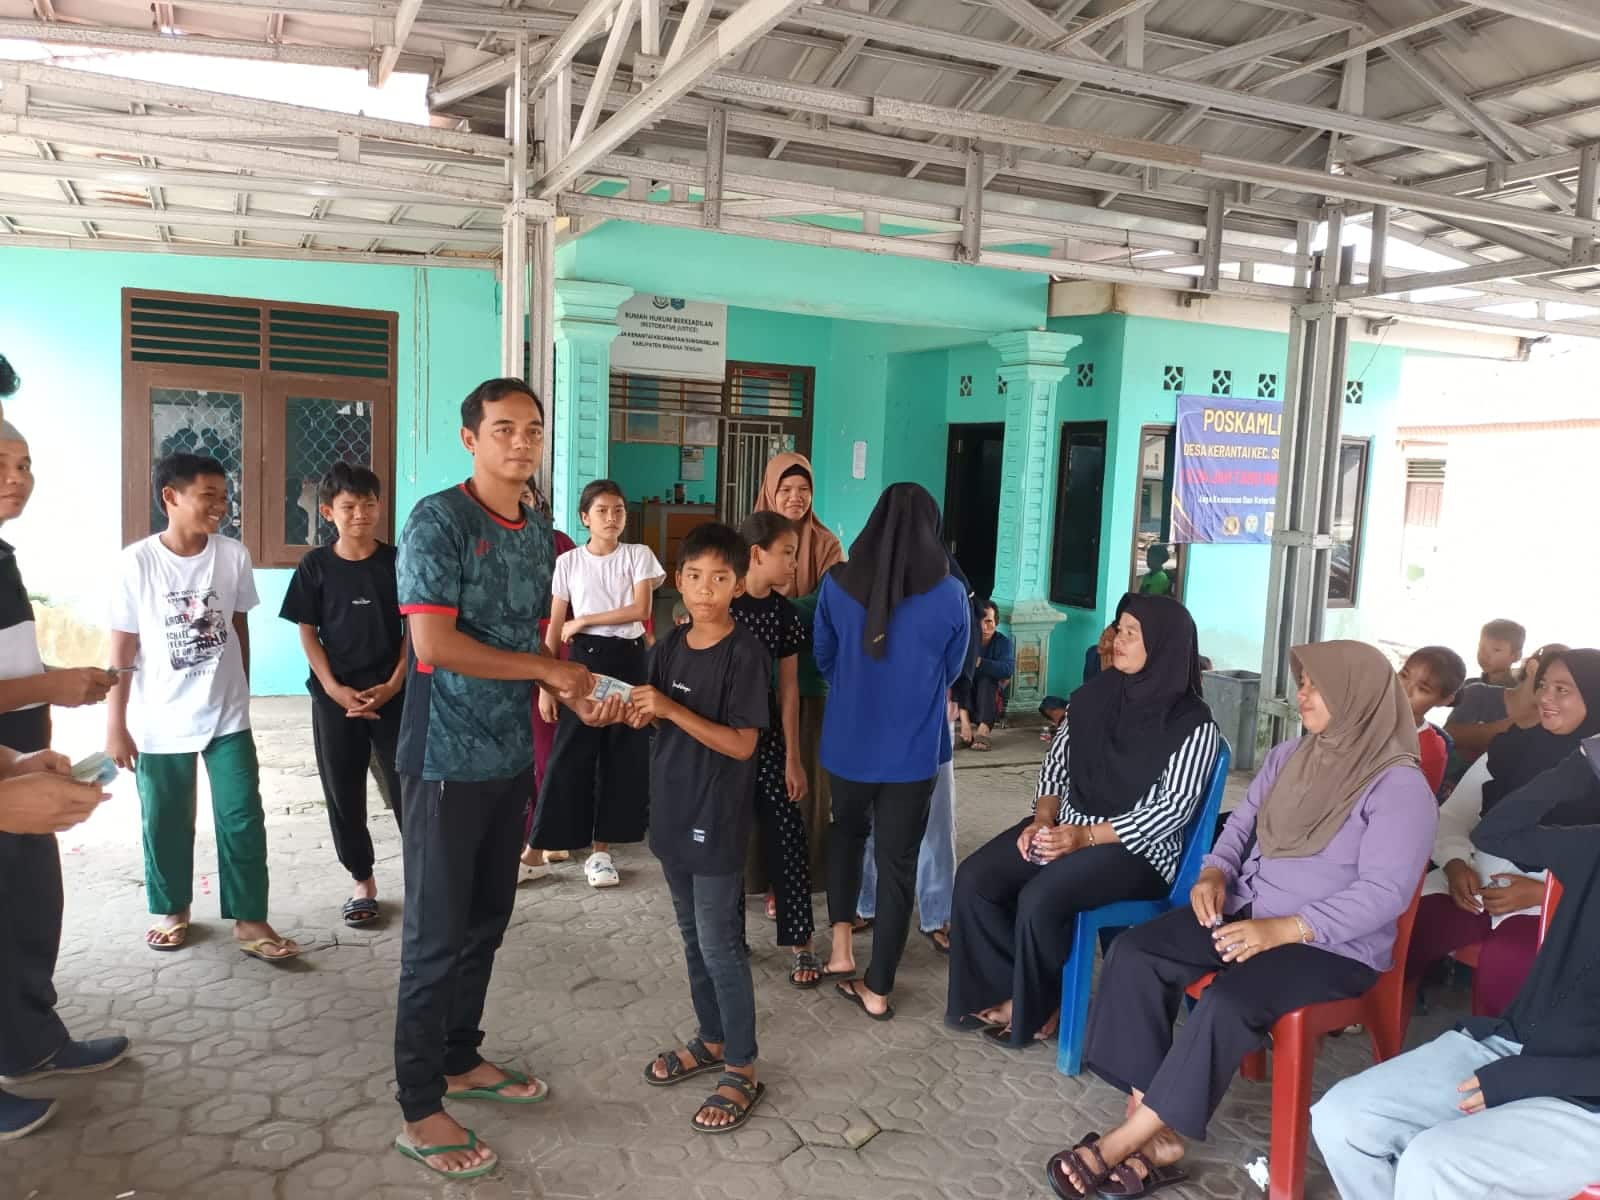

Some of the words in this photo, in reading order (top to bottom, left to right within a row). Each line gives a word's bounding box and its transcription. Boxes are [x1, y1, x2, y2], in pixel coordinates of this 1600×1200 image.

[624, 311, 648, 321] RUMAH
[649, 313, 672, 323] HUKUM
[1203, 409, 1282, 435] POSKAMLI
[1183, 443, 1207, 457] DESA
[1207, 444, 1251, 459] KERANTAI
[1251, 446, 1270, 460] KEC.
